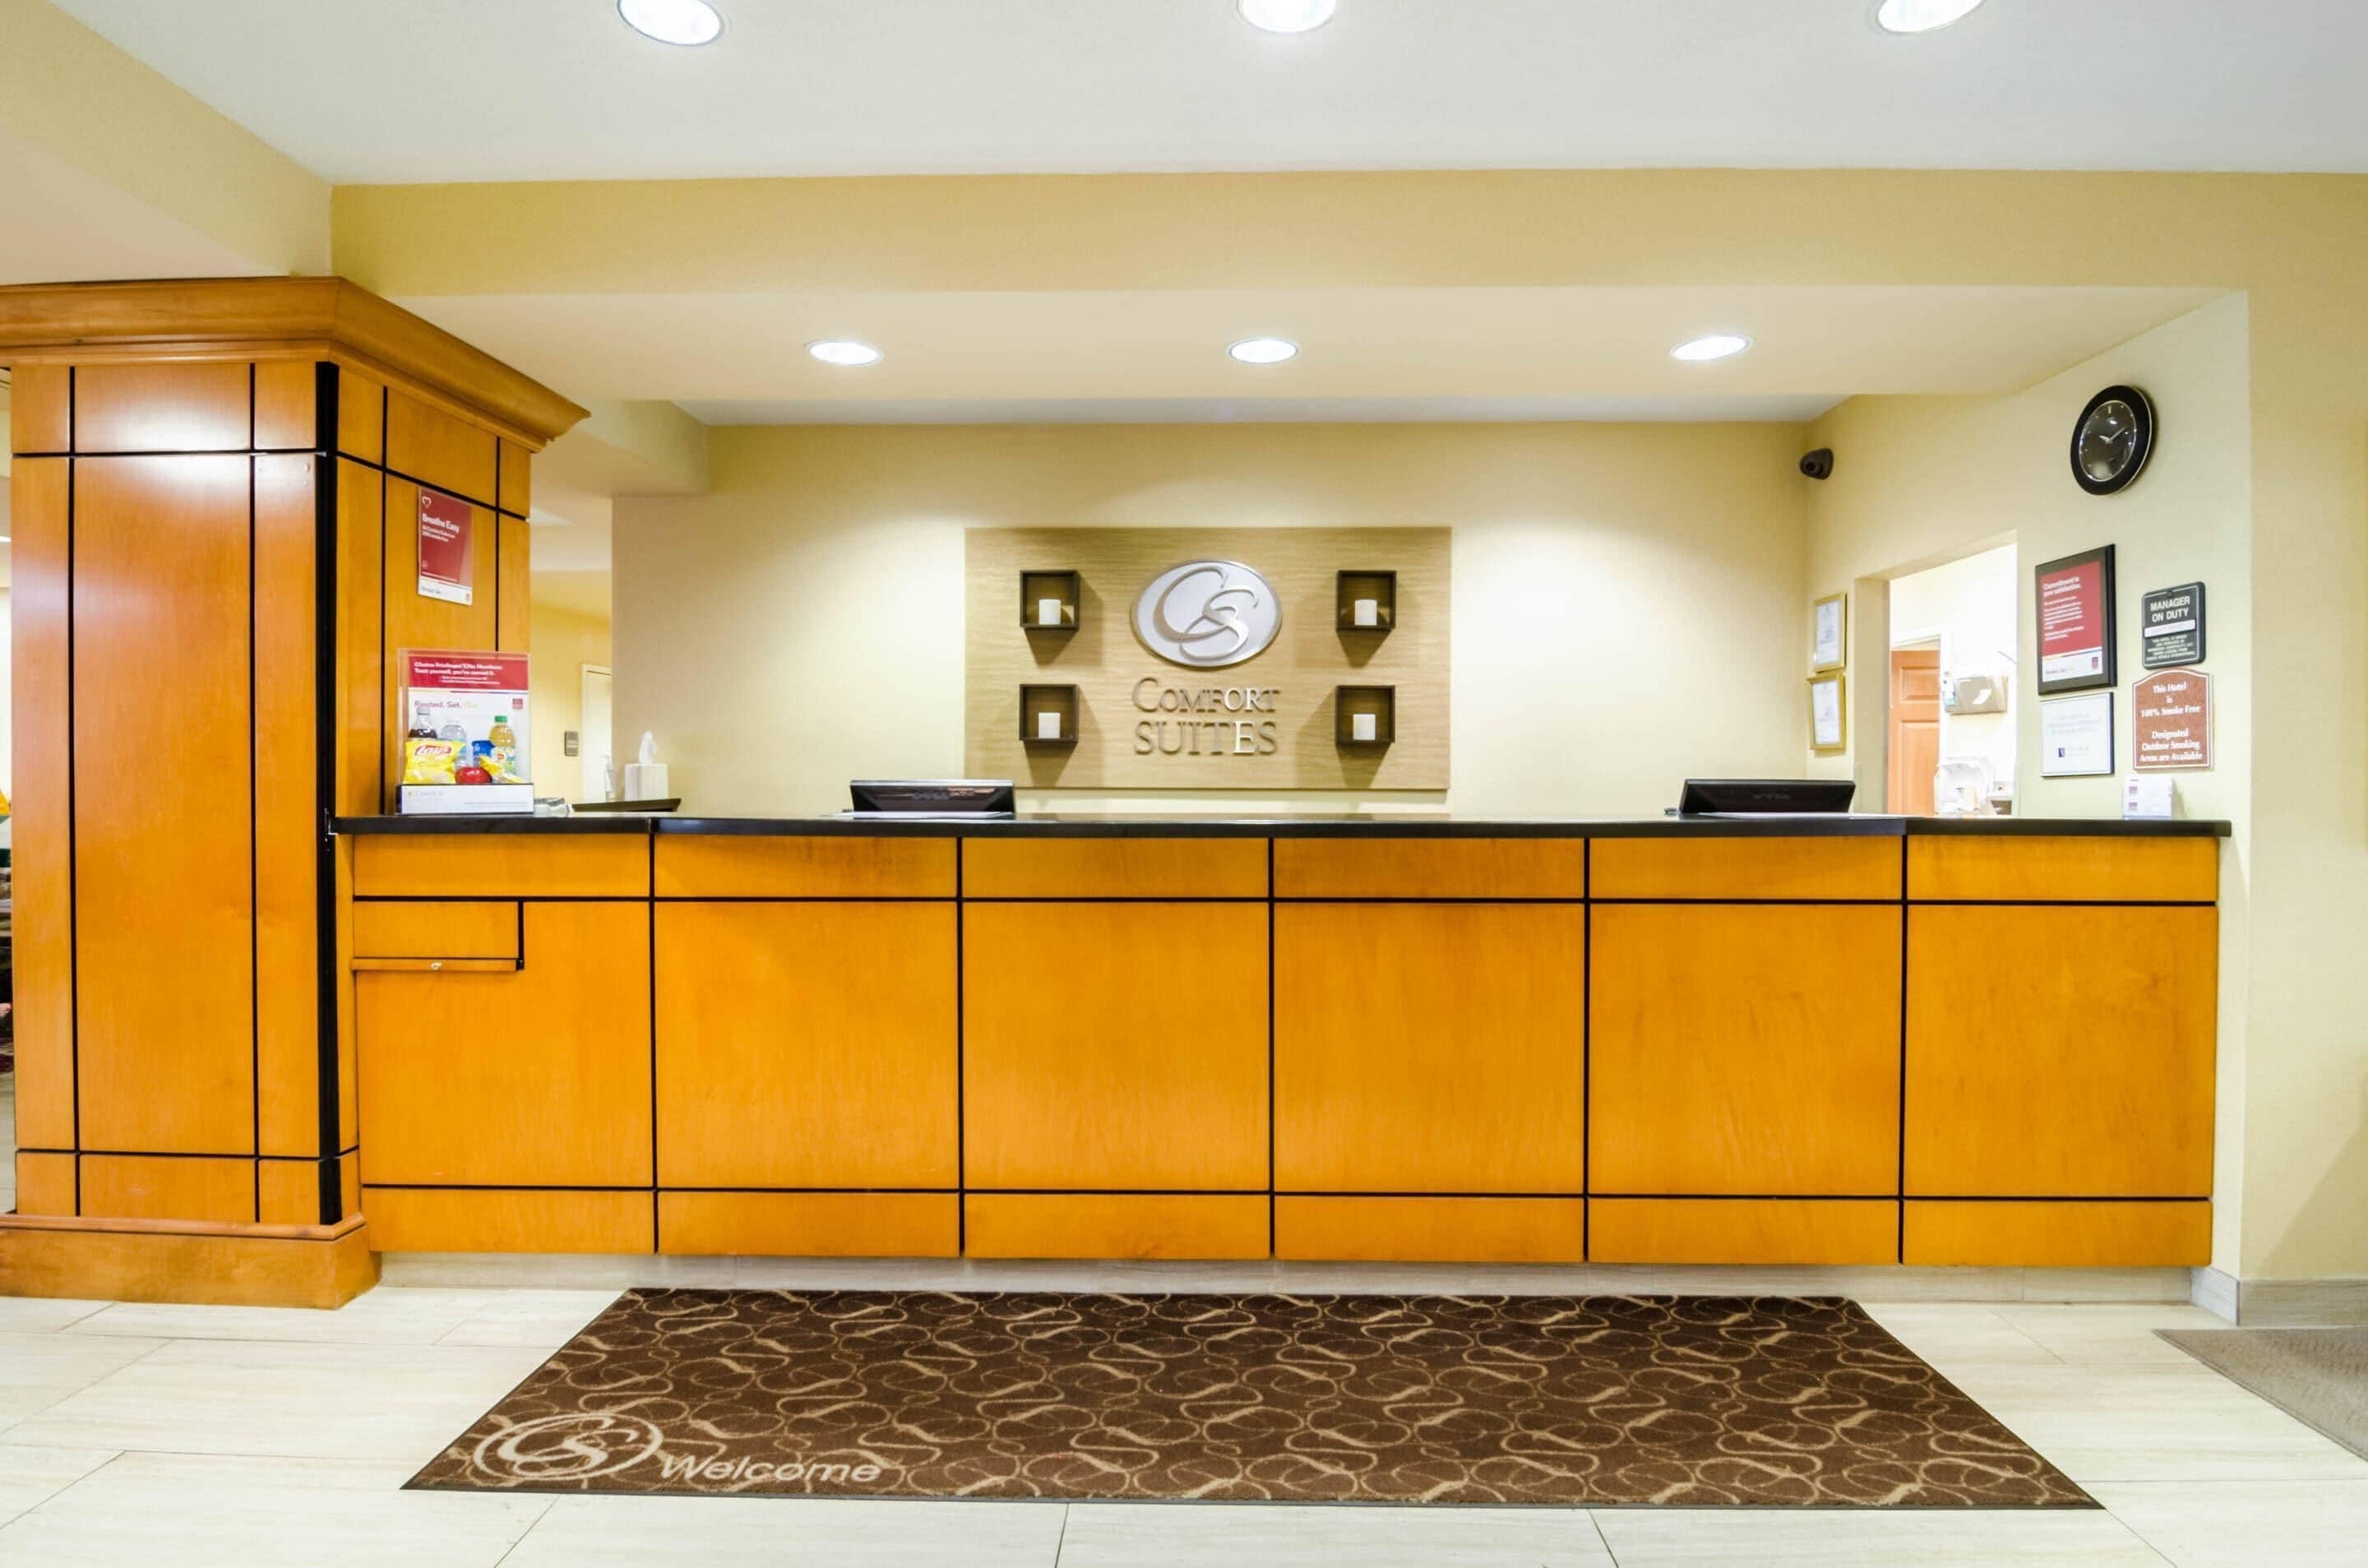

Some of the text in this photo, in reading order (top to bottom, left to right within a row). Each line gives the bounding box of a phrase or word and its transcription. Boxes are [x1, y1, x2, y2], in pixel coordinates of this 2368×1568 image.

[2150, 596, 2190, 611] MANAGER
[2152, 607, 2190, 622] ON DUTY
[2153, 682, 2187, 693] This Hotel
[2166, 696, 2173, 704] is
[2141, 704, 2201, 718] 100% Smoke Free
[1133, 720, 1278, 756] SUITES
[2151, 728, 2190, 741] Designated
[2141, 739, 2200, 752] Outdoor Smoking
[2139, 750, 2204, 762] Areas are Available
[662, 1455, 883, 1482] Welcome
